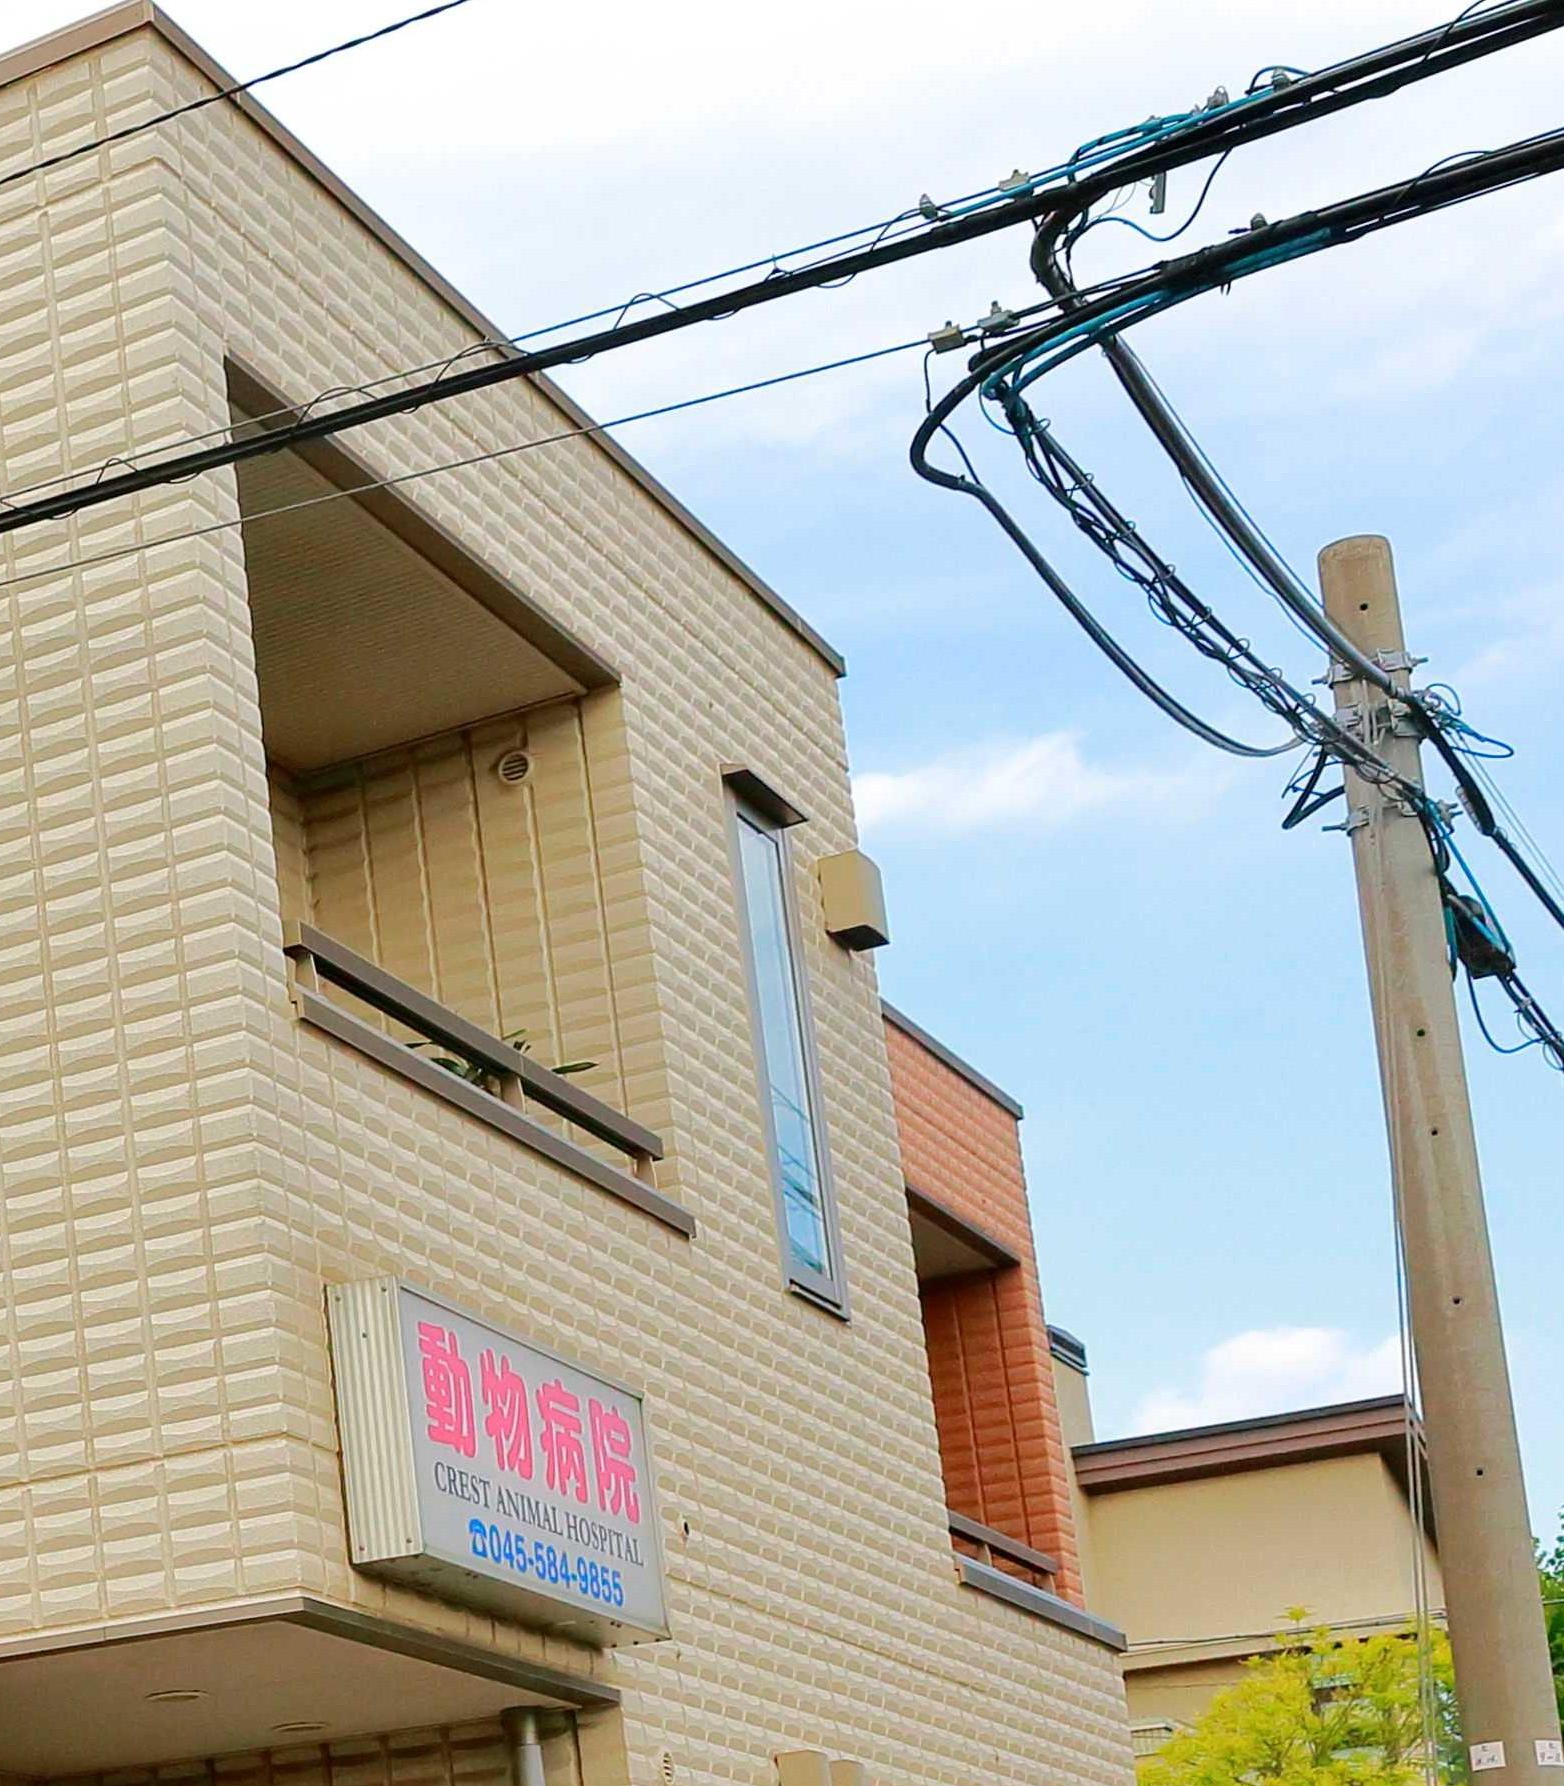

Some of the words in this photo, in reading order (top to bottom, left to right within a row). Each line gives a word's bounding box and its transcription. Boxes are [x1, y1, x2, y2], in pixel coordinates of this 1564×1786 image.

[416, 1320, 641, 1525] 動物病院
[433, 1461, 490, 1510] CREST
[496, 1485, 563, 1537] ANIMAL
[565, 1513, 644, 1567] HOSPITAL
[488, 1524, 625, 1608] 045-584-9855
